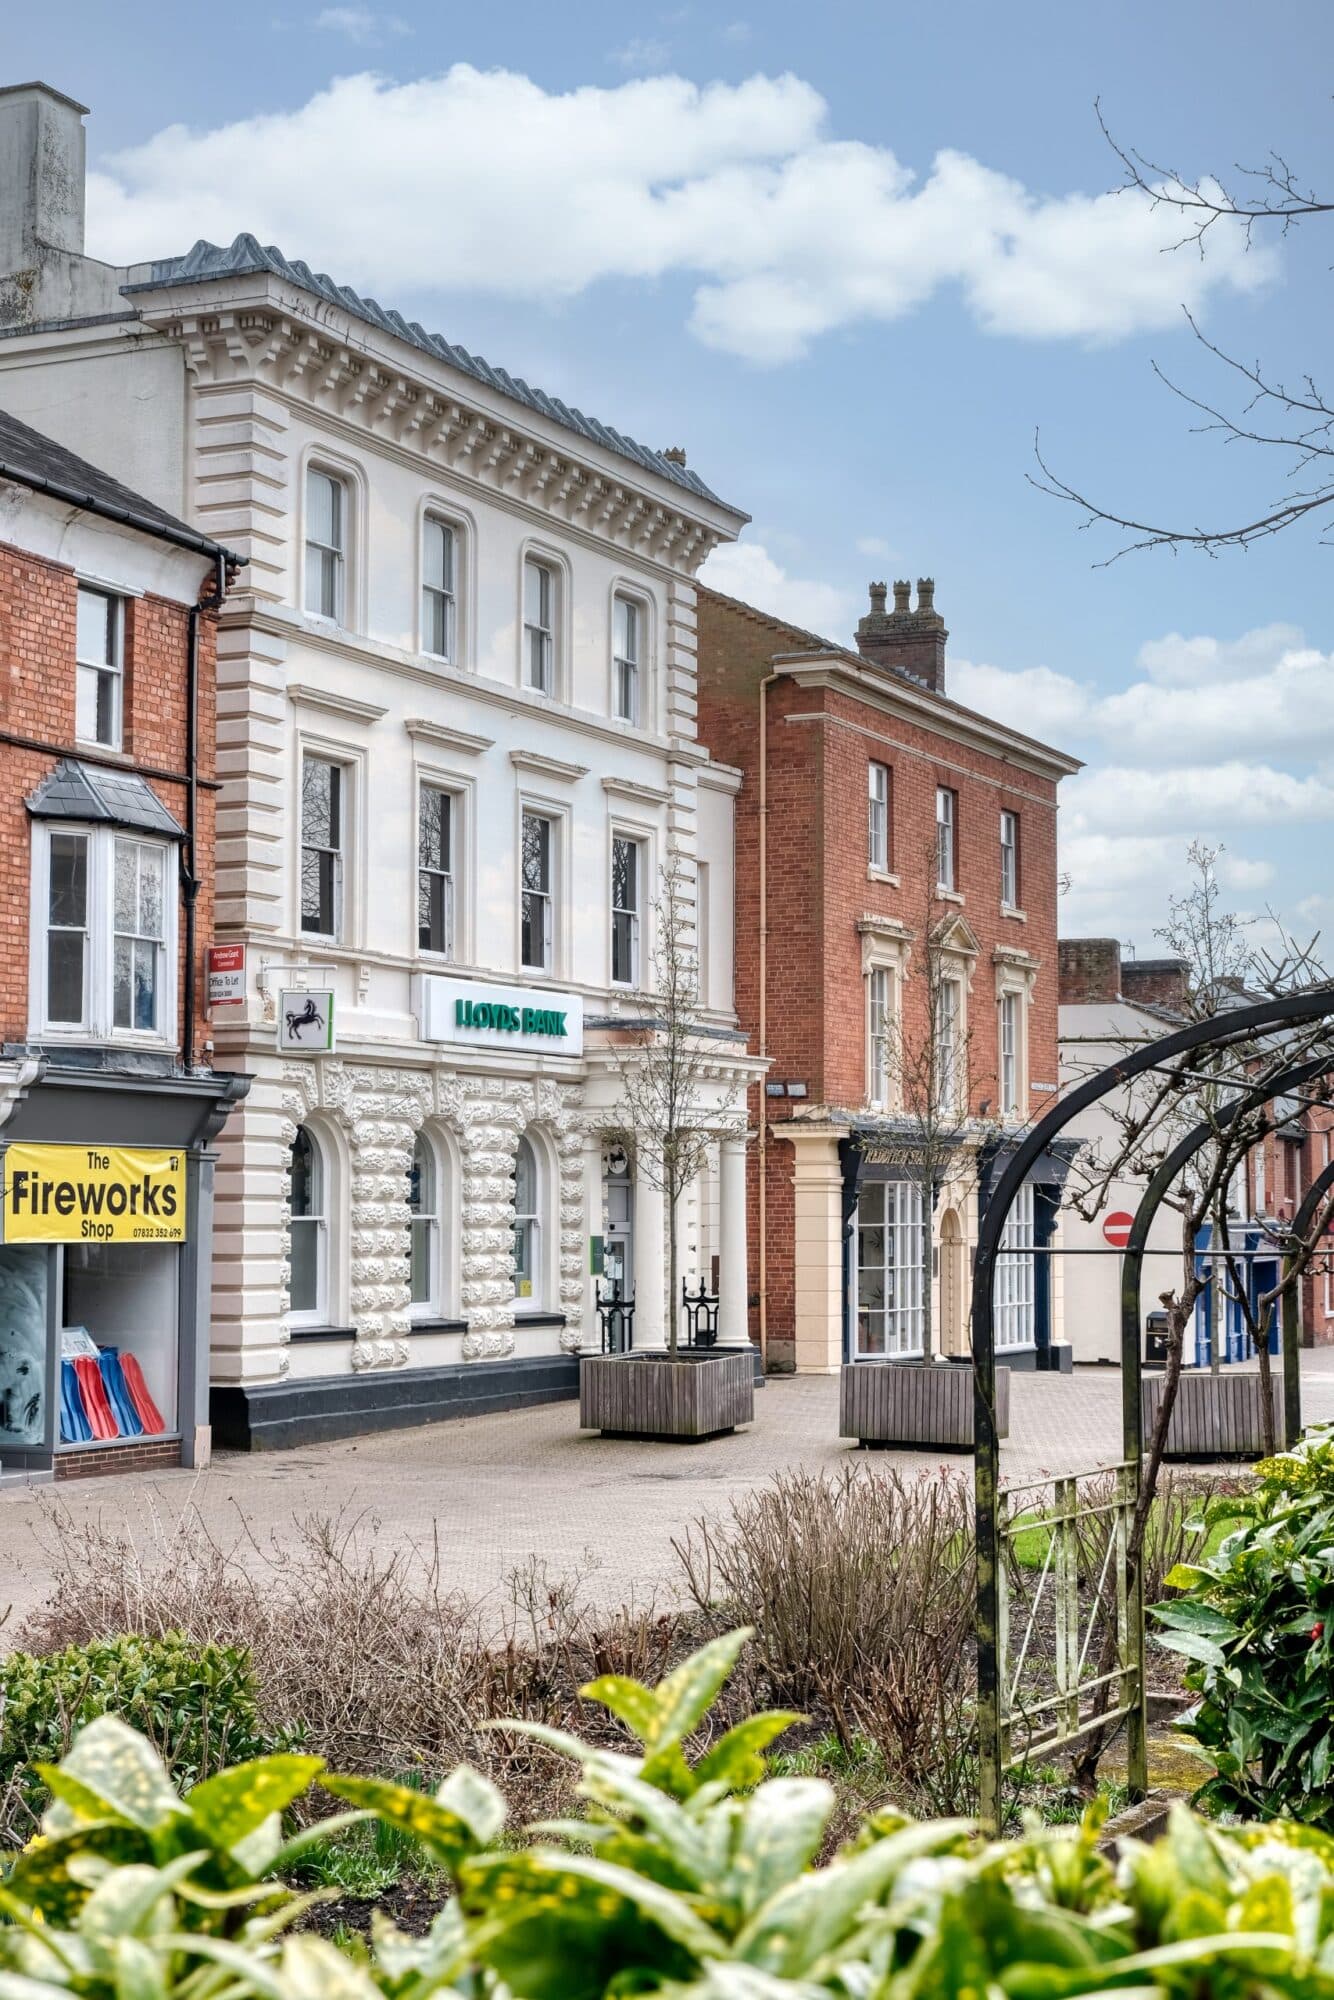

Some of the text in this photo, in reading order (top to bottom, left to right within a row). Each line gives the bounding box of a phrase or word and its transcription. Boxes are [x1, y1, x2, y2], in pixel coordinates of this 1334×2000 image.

[209, 976, 239, 987] Office To Let
[455, 999, 568, 1036] LLOYDS BANK
[87, 1152, 110, 1169] The
[12, 1171, 177, 1216] Fireworks
[81, 1219, 114, 1241] Shop
[133, 1227, 182, 1238] 07832 352 699
